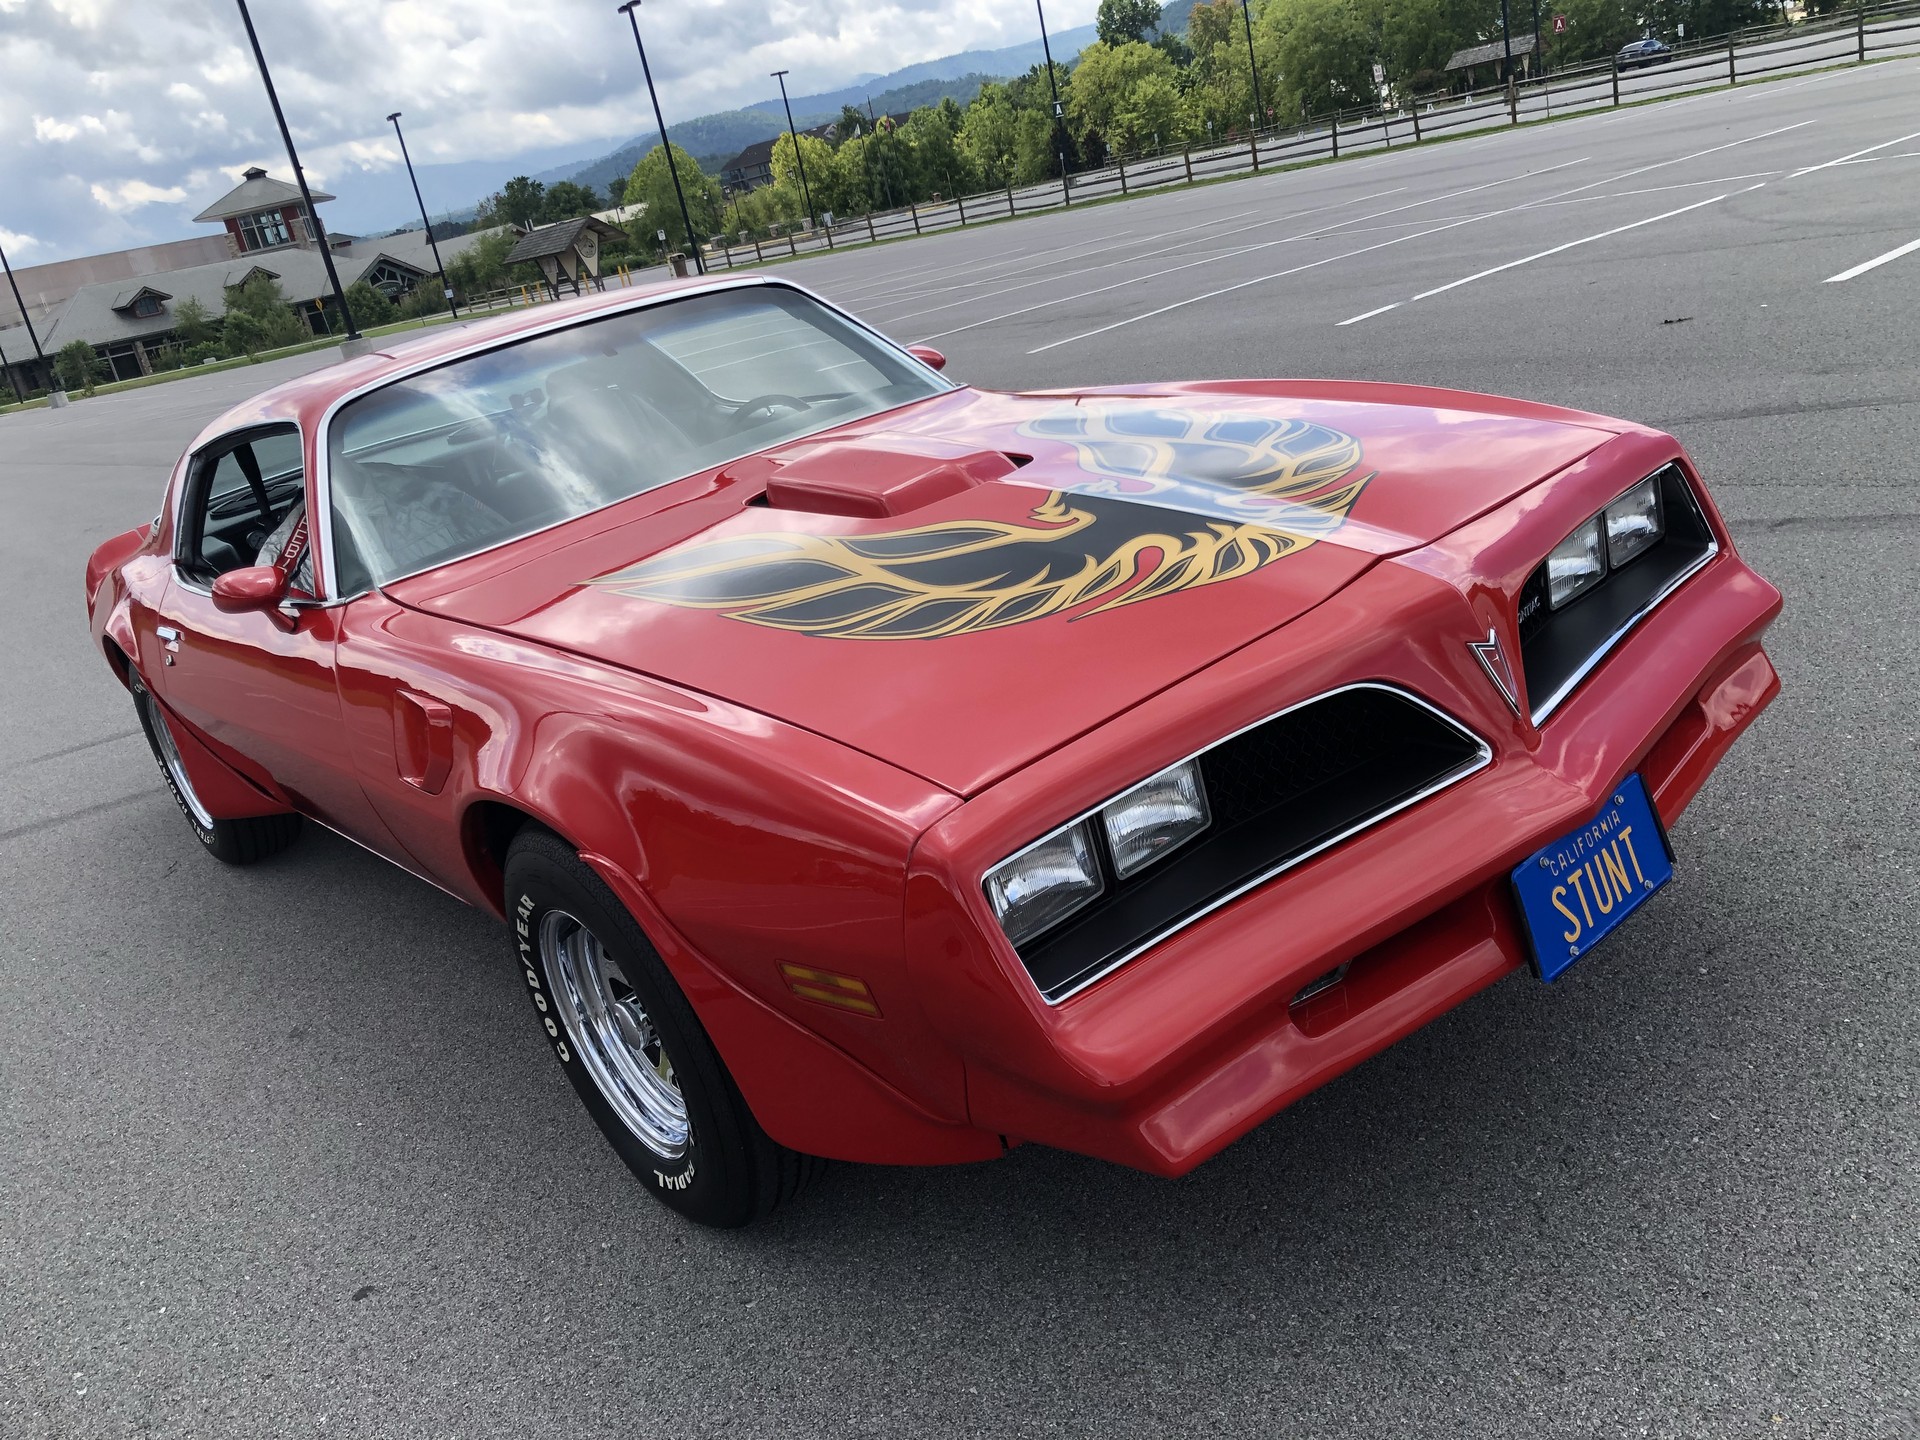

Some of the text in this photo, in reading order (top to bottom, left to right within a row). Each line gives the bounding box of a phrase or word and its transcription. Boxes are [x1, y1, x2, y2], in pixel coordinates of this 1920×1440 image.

[1056, 104, 1063, 115] A
[1517, 595, 1541, 624] ONTIAC
[1549, 809, 1621, 877] CALIFORNIA
[1551, 825, 1644, 944] STUNT
[653, 1160, 695, 1191] RADIAL
